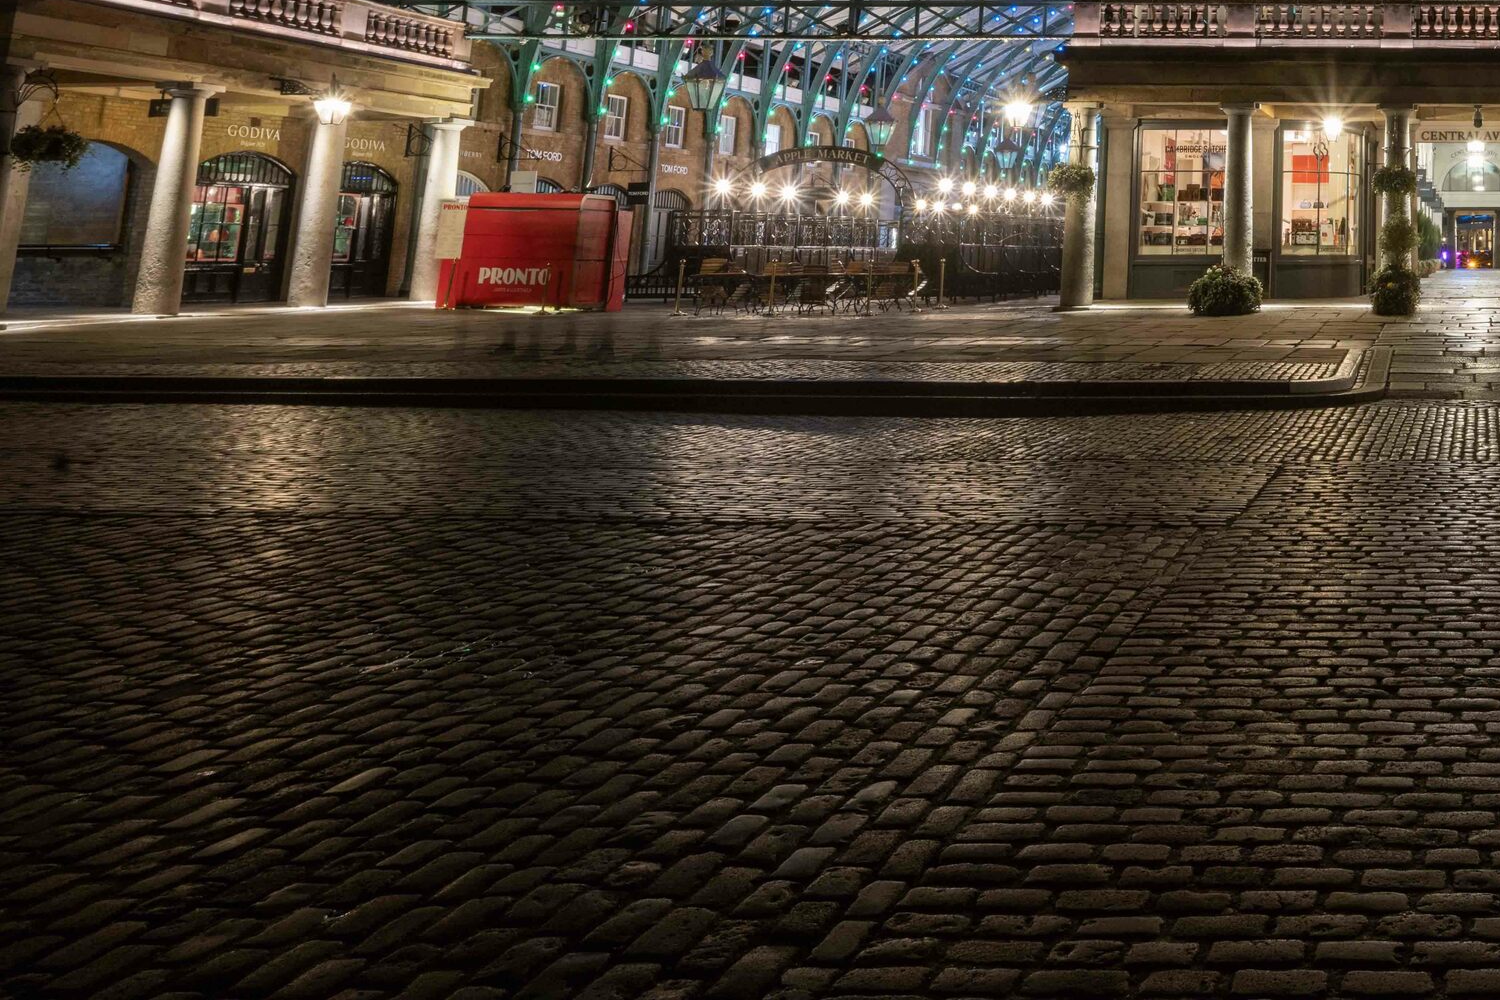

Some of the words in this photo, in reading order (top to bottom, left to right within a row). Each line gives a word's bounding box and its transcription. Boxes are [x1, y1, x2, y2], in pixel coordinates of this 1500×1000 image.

[227, 124, 281, 141] GODIVA
[1421, 130, 1478, 140] CENTRAL
[344, 137, 385, 151] GODIVA
[526, 149, 542, 158] TOM
[542, 151, 562, 161] FORD
[775, 149, 811, 164] APPLE
[818, 149, 870, 164] MARKET
[661, 164, 673, 173] TOM
[673, 166, 688, 175] FORD
[443, 203, 468, 211] PRONTO
[478, 267, 551, 286] PRONTO
